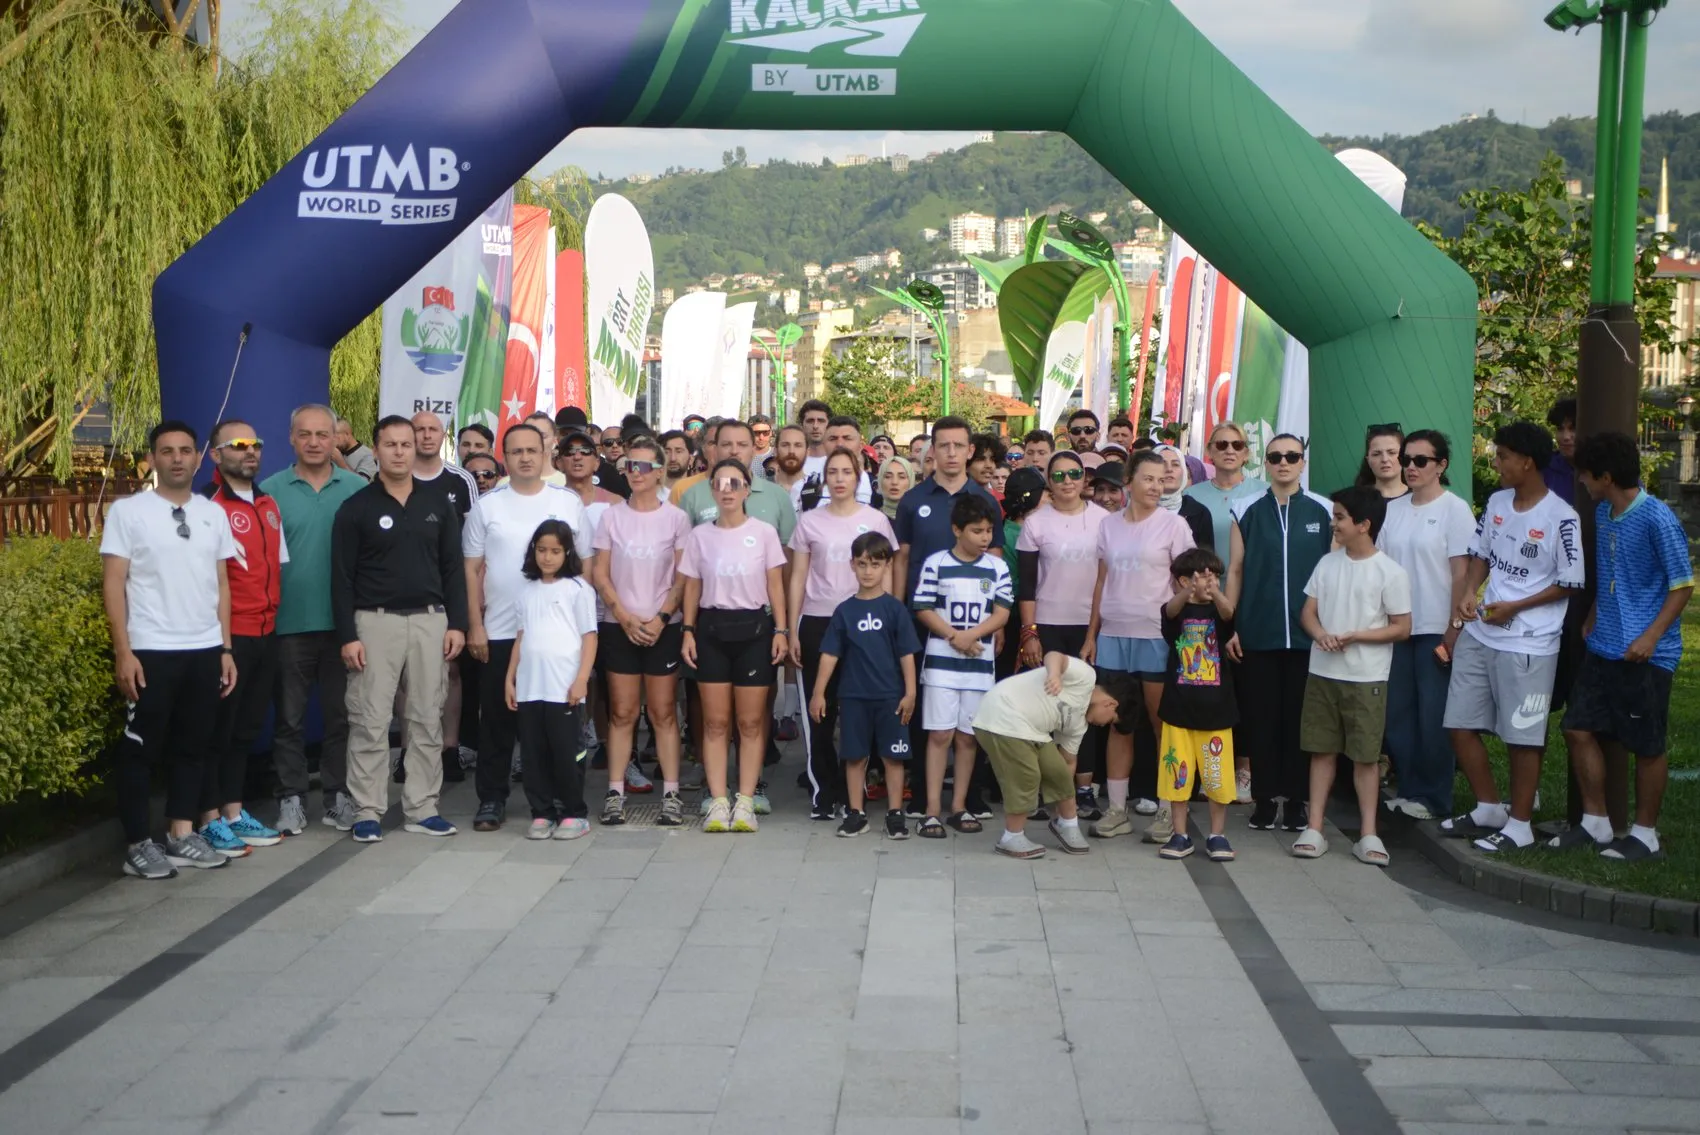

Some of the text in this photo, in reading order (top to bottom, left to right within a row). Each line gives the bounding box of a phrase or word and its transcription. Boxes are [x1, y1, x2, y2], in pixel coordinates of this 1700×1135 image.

[764, 70, 880, 91] BY UTMB
[303, 143, 460, 192] UTMB
[306, 197, 450, 219] WORLD SERIES
[413, 396, 453, 415] RİZE
[1497, 558, 1530, 577] blaze
[857, 612, 883, 632] alo
[1521, 694, 1551, 712] NIK
[890, 739, 909, 753] alo
